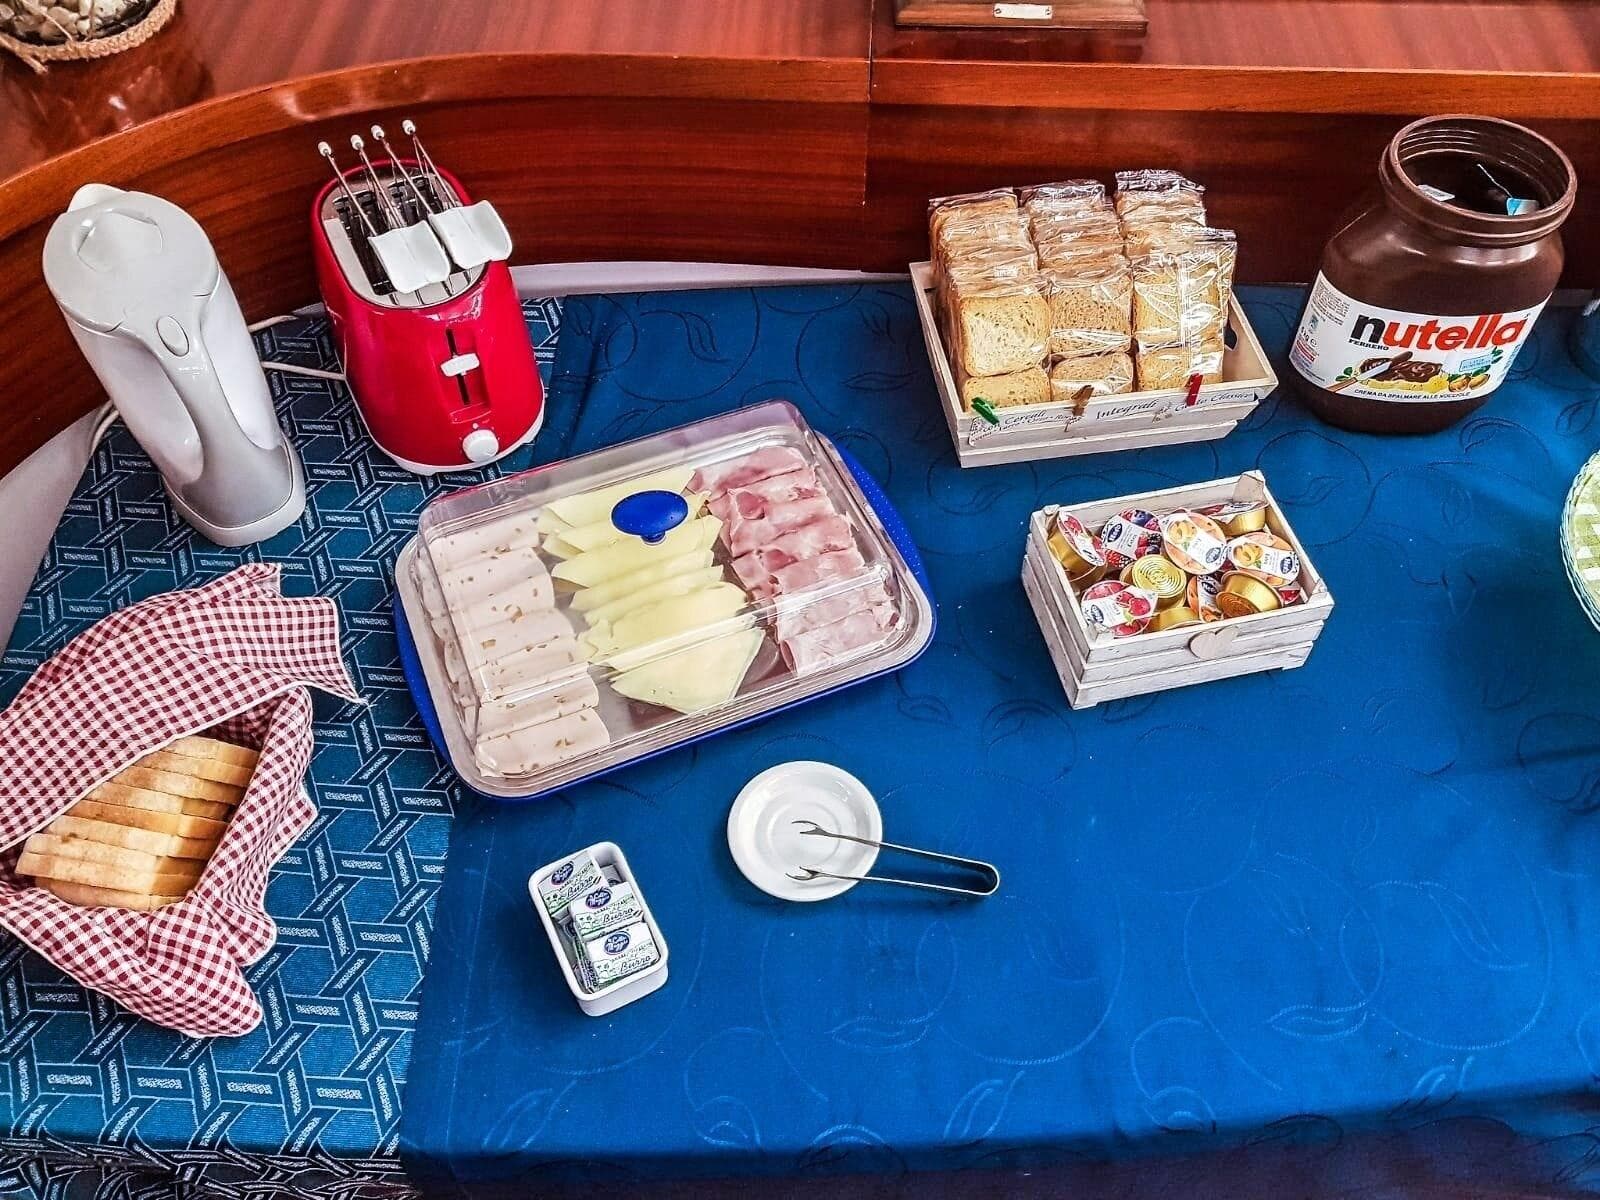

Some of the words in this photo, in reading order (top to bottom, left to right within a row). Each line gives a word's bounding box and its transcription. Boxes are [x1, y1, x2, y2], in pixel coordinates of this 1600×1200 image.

[1350, 313, 1529, 351] nutella
[1348, 338, 1390, 351] FERRERO
[1354, 387, 1377, 397] CREMA
[1387, 392, 1421, 400] SPALMARE
[1439, 391, 1471, 399] NOCCIOLE
[1004, 409, 1047, 425] Cereali
[1096, 398, 1158, 420] Integrali
[566, 875, 594, 898] Burro
[602, 908, 634, 924] Burro
[620, 955, 652, 972] Burro
